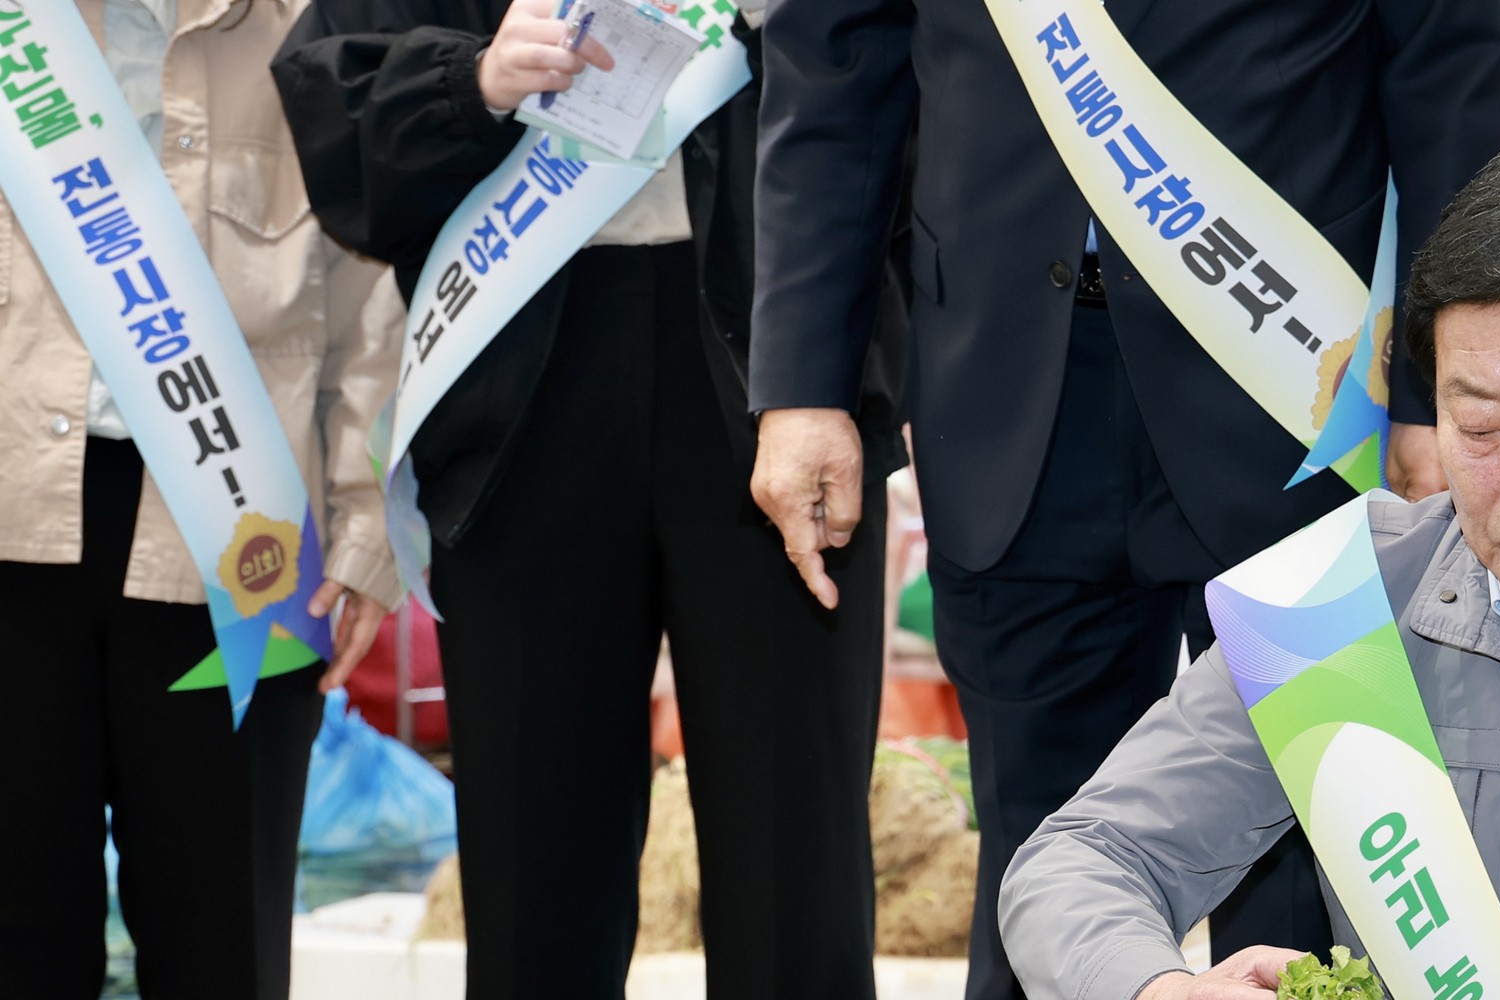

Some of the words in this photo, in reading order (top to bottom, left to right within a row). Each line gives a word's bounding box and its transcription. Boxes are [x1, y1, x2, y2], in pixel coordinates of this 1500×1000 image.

[52, 157, 246, 508] 전통시장에서!
[1035, 12, 1323, 354] 전통시장에서!
[1359, 811, 1450, 950] 우리
